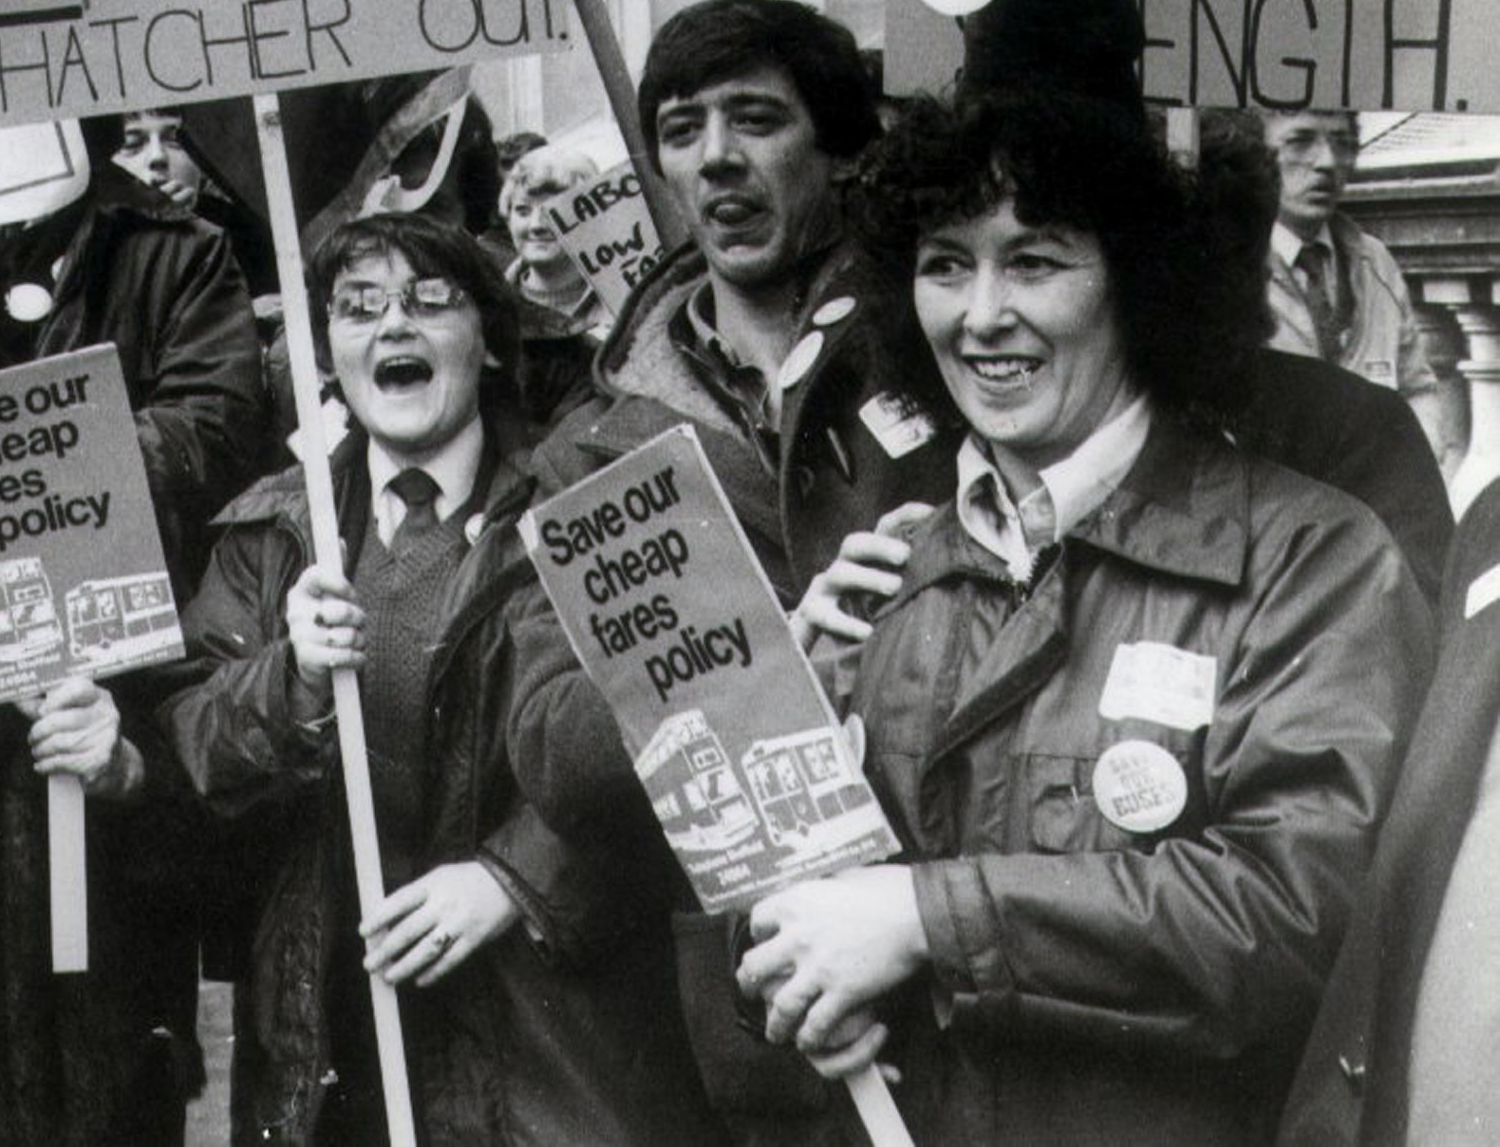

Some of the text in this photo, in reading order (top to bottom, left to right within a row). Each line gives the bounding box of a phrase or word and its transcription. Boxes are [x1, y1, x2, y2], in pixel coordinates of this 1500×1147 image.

[549, 173, 643, 236] LABO
[577, 220, 645, 276] LOW
[25, 370, 92, 417] our
[541, 461, 684, 569] Save our
[582, 525, 691, 610] cheap
[588, 598, 680, 661] fares
[643, 615, 754, 703] policy
